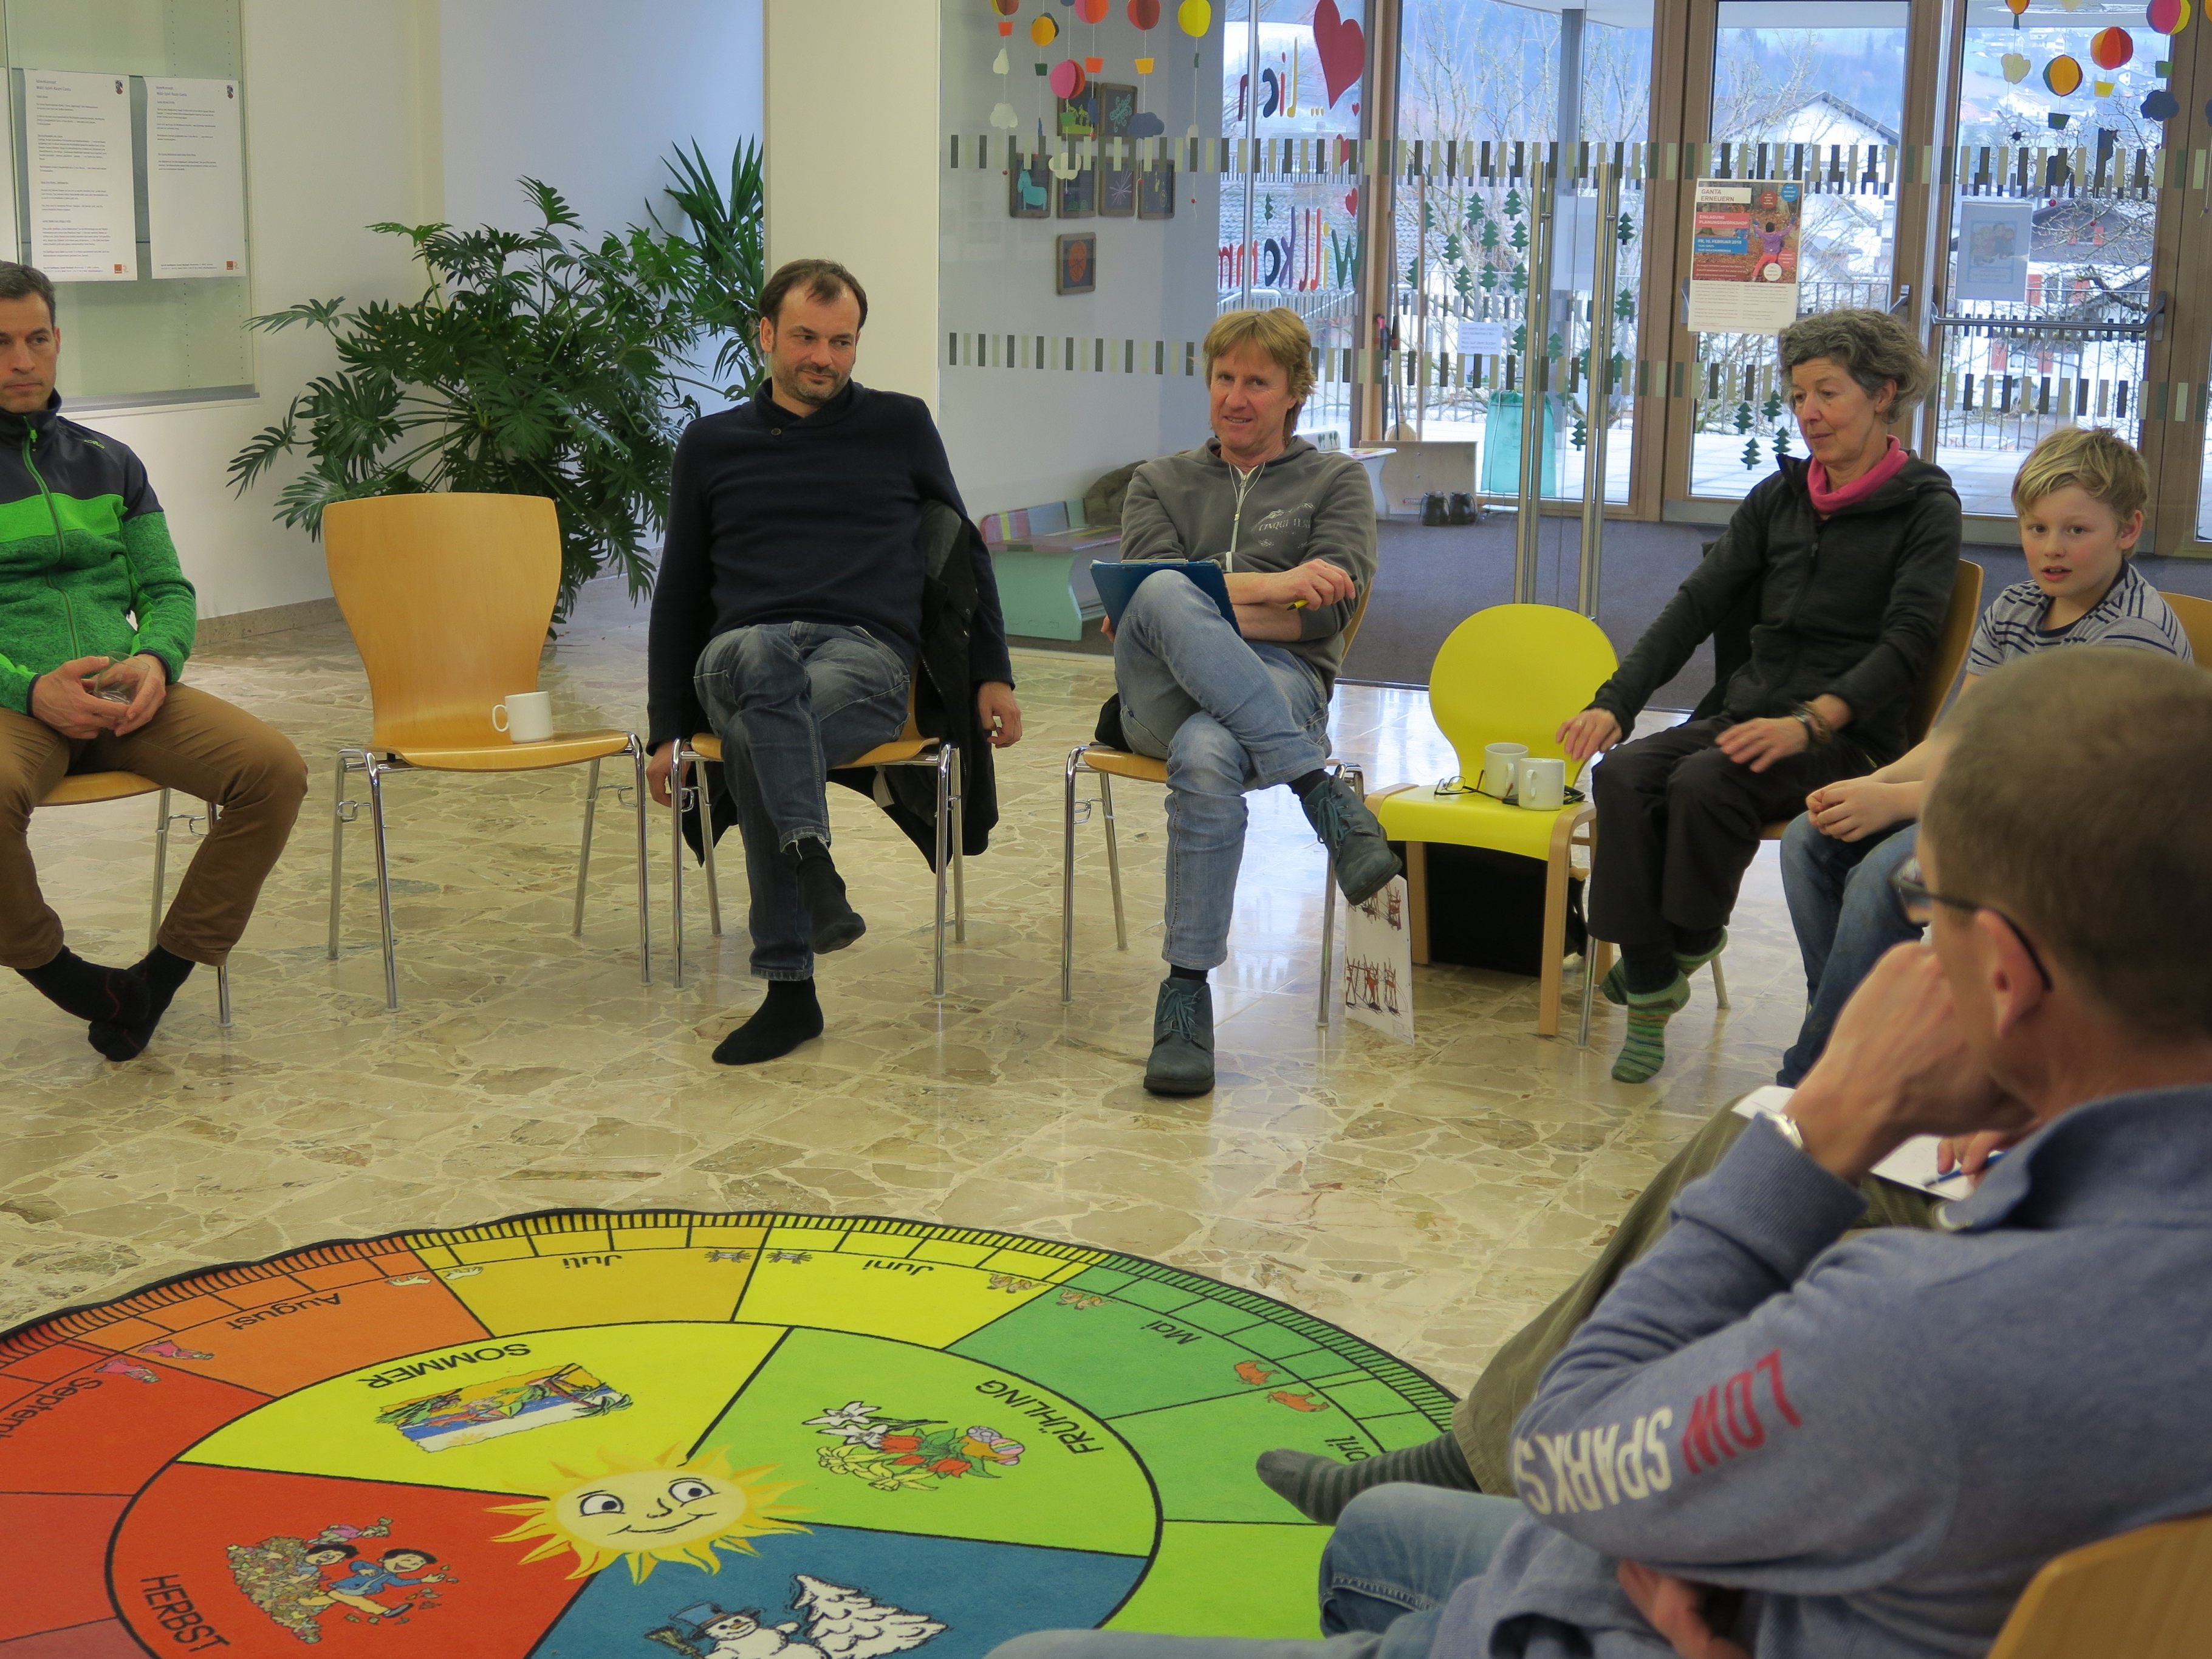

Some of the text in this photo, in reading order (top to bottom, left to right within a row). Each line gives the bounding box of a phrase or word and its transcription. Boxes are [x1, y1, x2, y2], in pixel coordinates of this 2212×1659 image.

[563, 1254, 622, 1269] Juli
[862, 1259, 934, 1276] Juni
[225, 1293, 341, 1330] August
[1140, 1320, 1202, 1344] Mai
[357, 1343, 532, 1389] SOMMER
[975, 1380, 1104, 1454] FRÜHLING
[1513, 1348, 1803, 1516] LOW SPARKS
[1324, 1435, 1371, 1462] pril
[140, 1573, 231, 1652] HERBST
